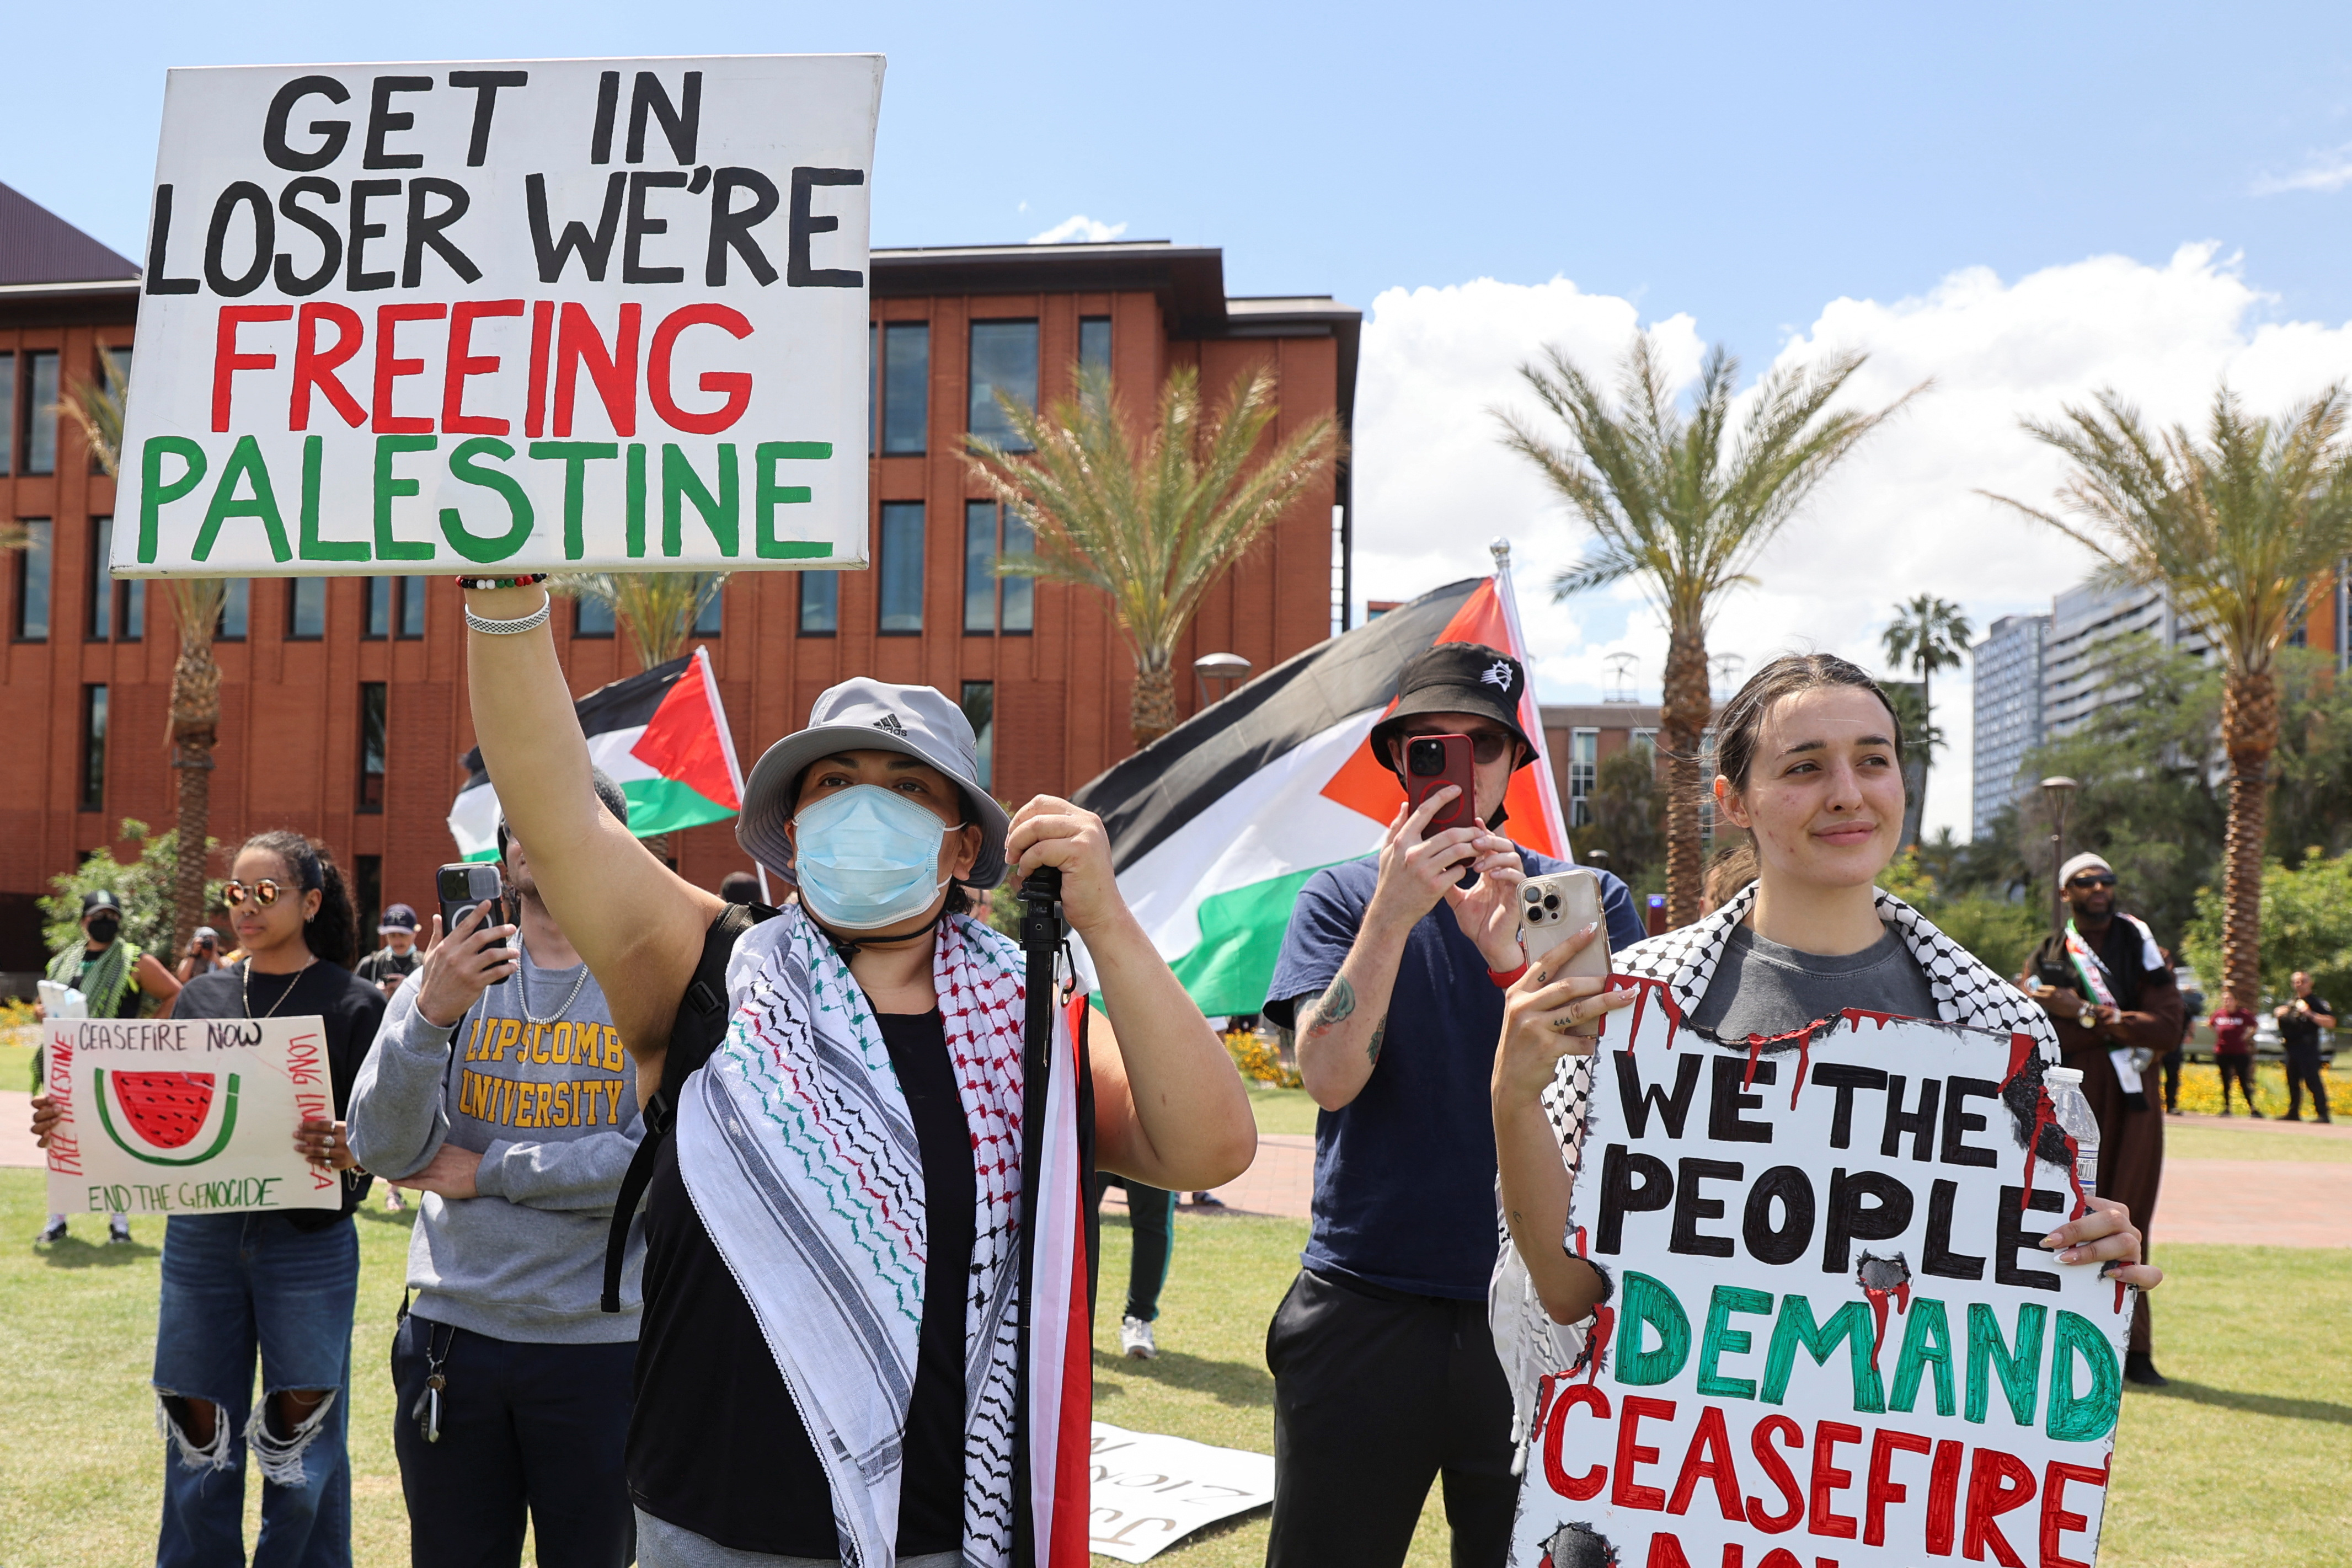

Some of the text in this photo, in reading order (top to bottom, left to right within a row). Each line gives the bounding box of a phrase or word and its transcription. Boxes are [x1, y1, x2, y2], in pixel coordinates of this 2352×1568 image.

[264, 71, 702, 172] GET IN
[146, 165, 864, 297] LOSER WE'RE
[212, 299, 753, 437] FREEING
[138, 435, 833, 564] PALESTINE
[79, 1021, 263, 1051] CEASEFIRE NOW
[287, 1033, 323, 1085] LONG
[464, 1018, 625, 1073] LIPSCOMB
[47, 1129, 83, 1176] FREE
[459, 1068, 624, 1128] UNIVERSITY
[1613, 1051, 2001, 1169] WE THE
[89, 1178, 281, 1212] END THE GENOCIDE
[1595, 1143, 2065, 1292] PEOPLE
[1615, 1270, 2122, 1442] DEMAND
[1543, 1382, 2106, 1568] CEASEFIRE
